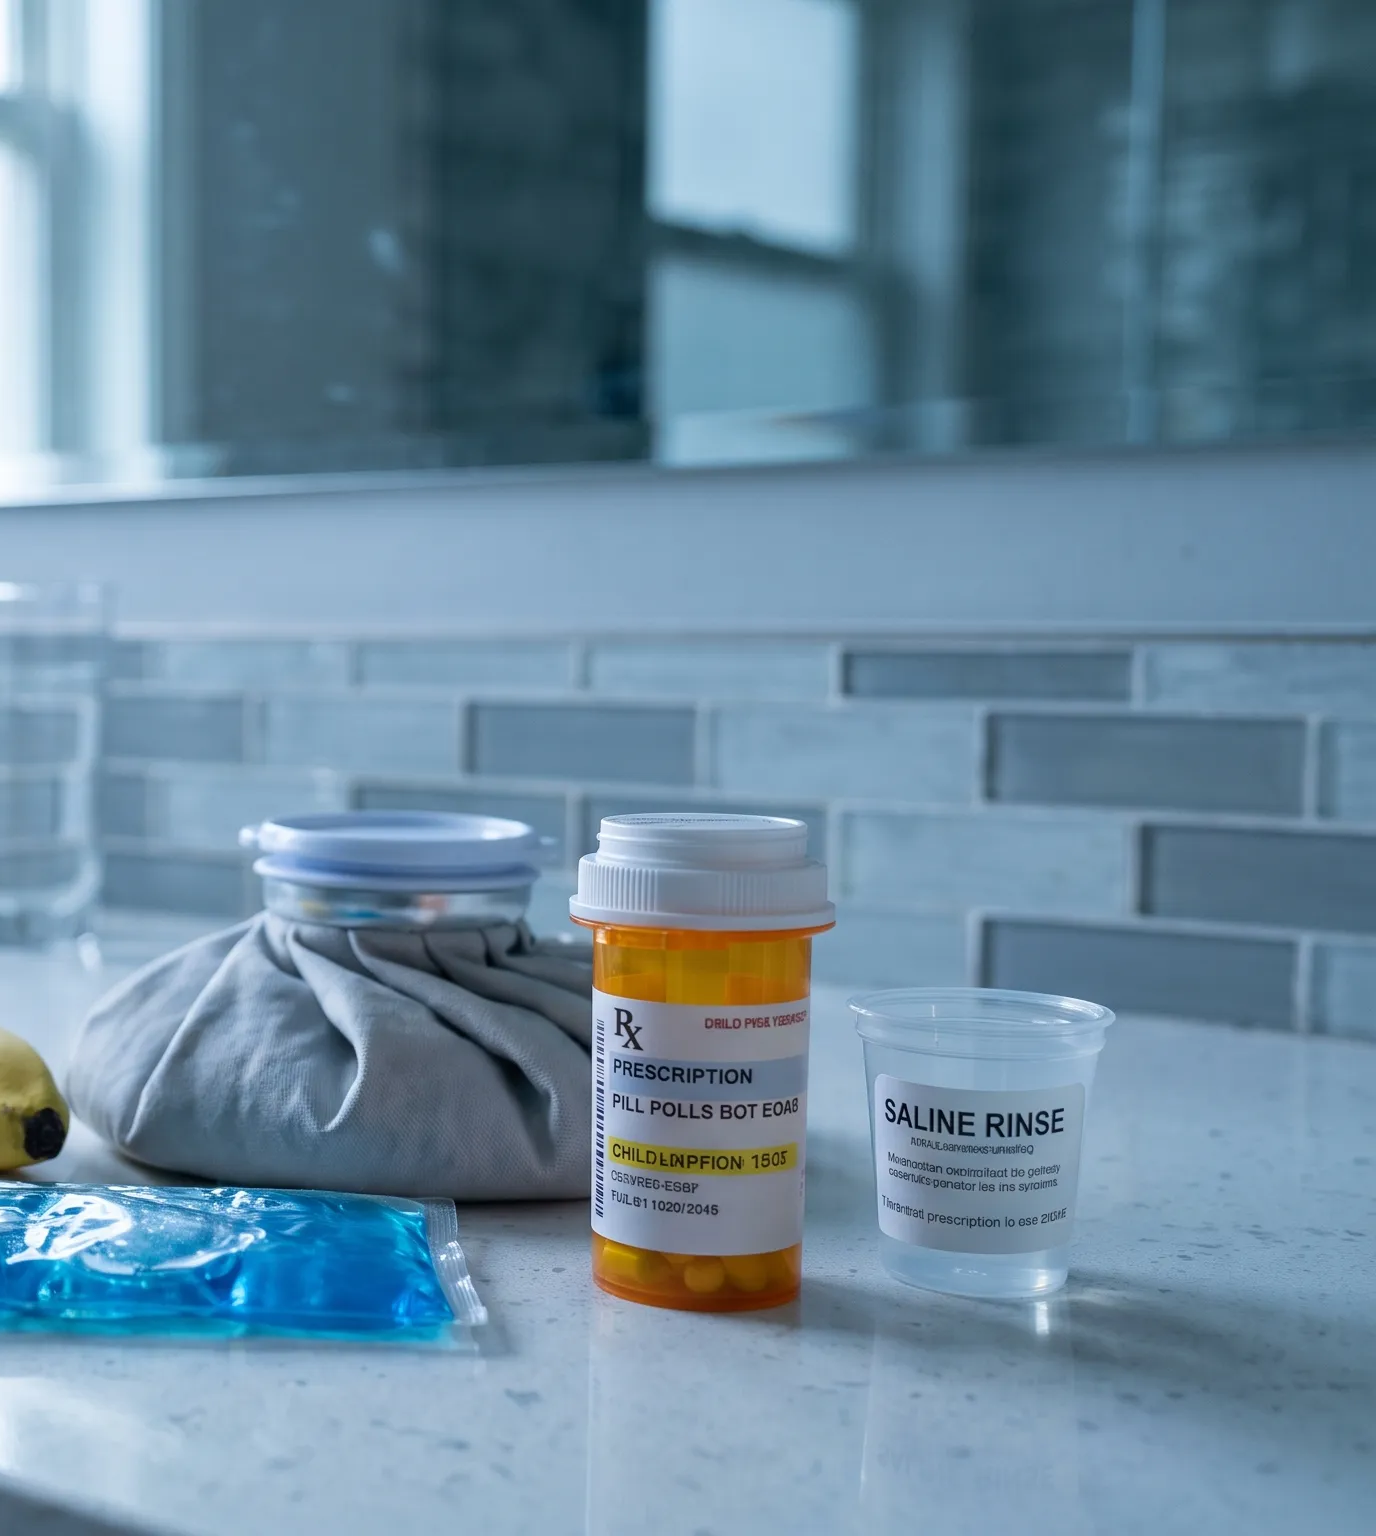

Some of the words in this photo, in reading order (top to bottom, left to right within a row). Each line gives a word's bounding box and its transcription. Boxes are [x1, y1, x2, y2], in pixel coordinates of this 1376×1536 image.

[614, 1007, 643, 1050] Rx
[613, 1059, 753, 1084] PRESCRIPTION
[612, 1094, 644, 1114] PILL
[650, 1100, 713, 1119] POLLS
[720, 1103, 758, 1120] BOT
[884, 1098, 975, 1137] SALINE
[986, 1107, 1065, 1138] RINSE
[927, 1211, 1001, 1229] prescription
[1018, 1216, 1038, 1227] ese
